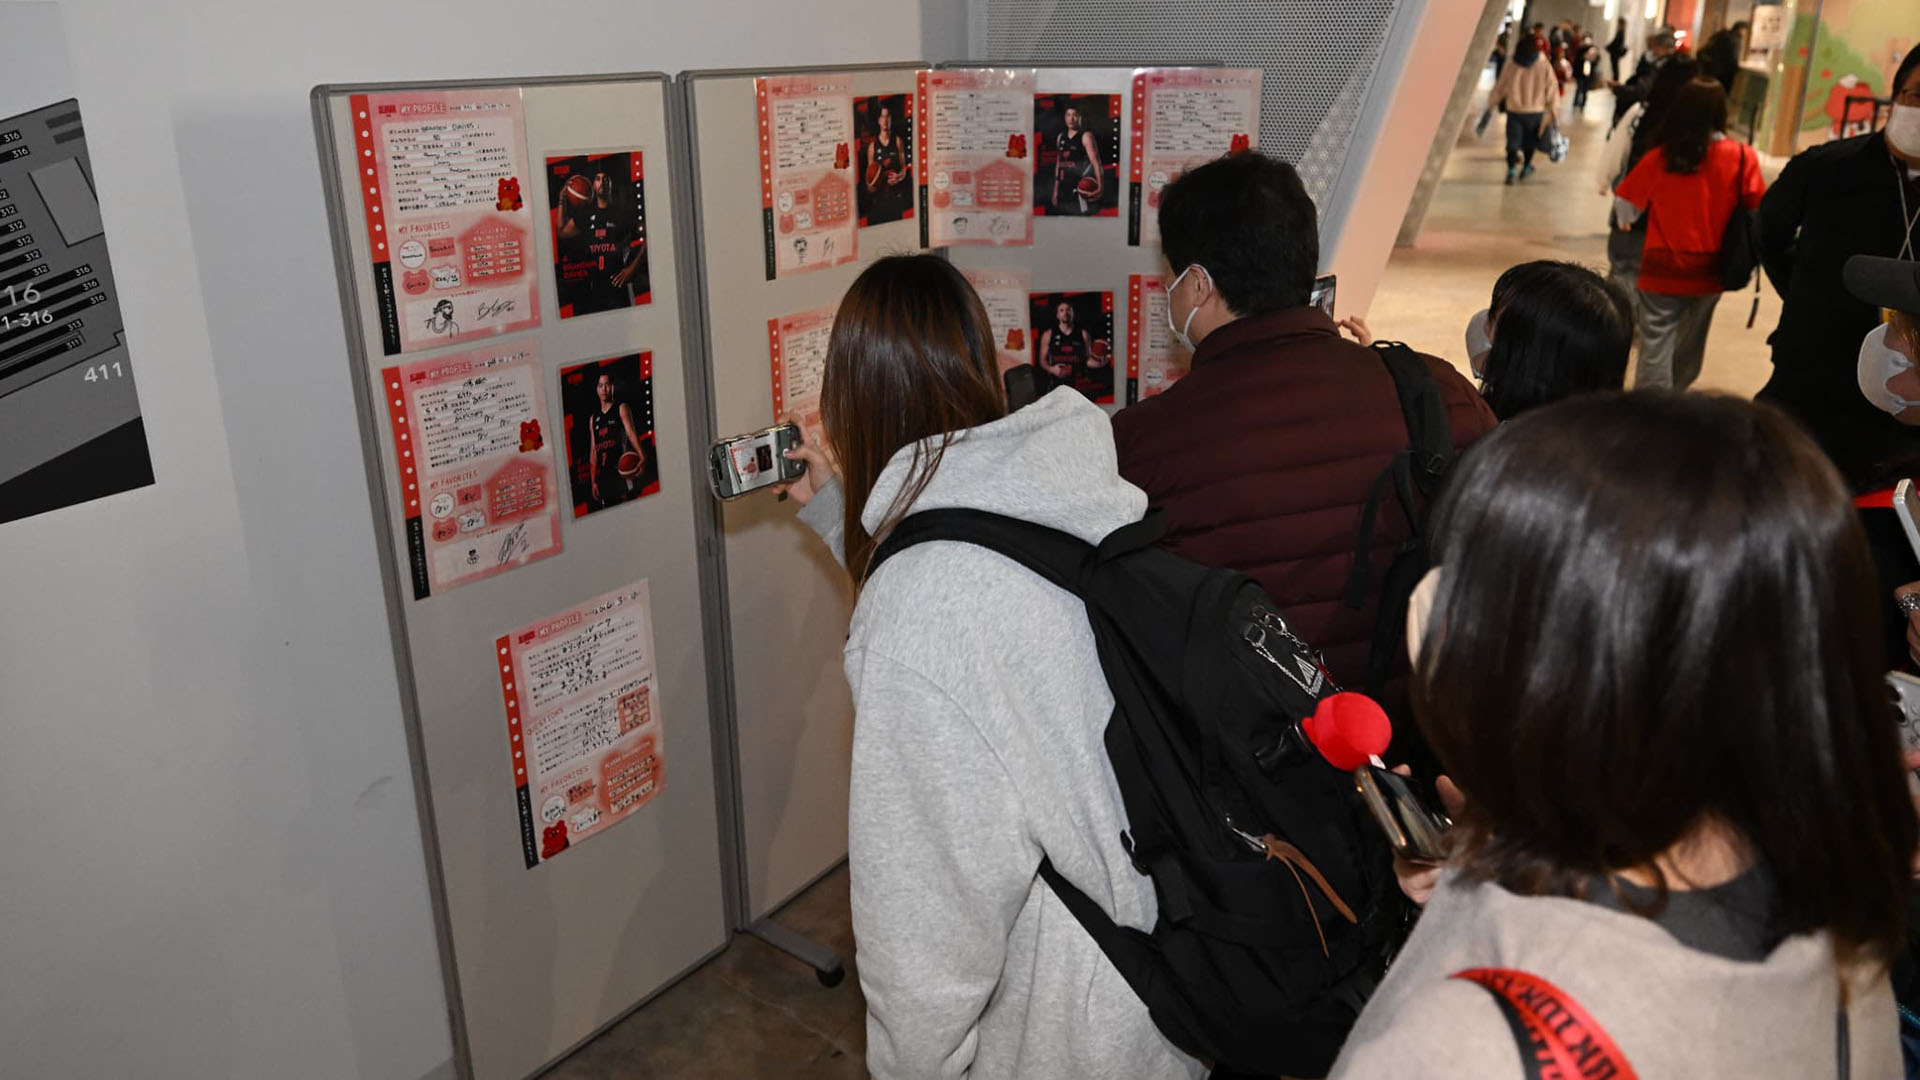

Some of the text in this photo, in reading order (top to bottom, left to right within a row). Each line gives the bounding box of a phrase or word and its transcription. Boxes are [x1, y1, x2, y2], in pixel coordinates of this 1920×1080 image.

[4, 132, 20, 142] 316
[11, 148, 28, 158] 316
[0, 206, 15, 217] 312
[8, 221, 24, 232] 312
[17, 235, 32, 247] 312
[24, 250, 40, 262] 312
[32, 264, 48, 277] 312
[75, 265, 91, 277] 316
[82, 280, 98, 292] 316
[90, 294, 105, 305] 316
[67, 320, 82, 331] 313
[84, 362, 122, 382] 411
